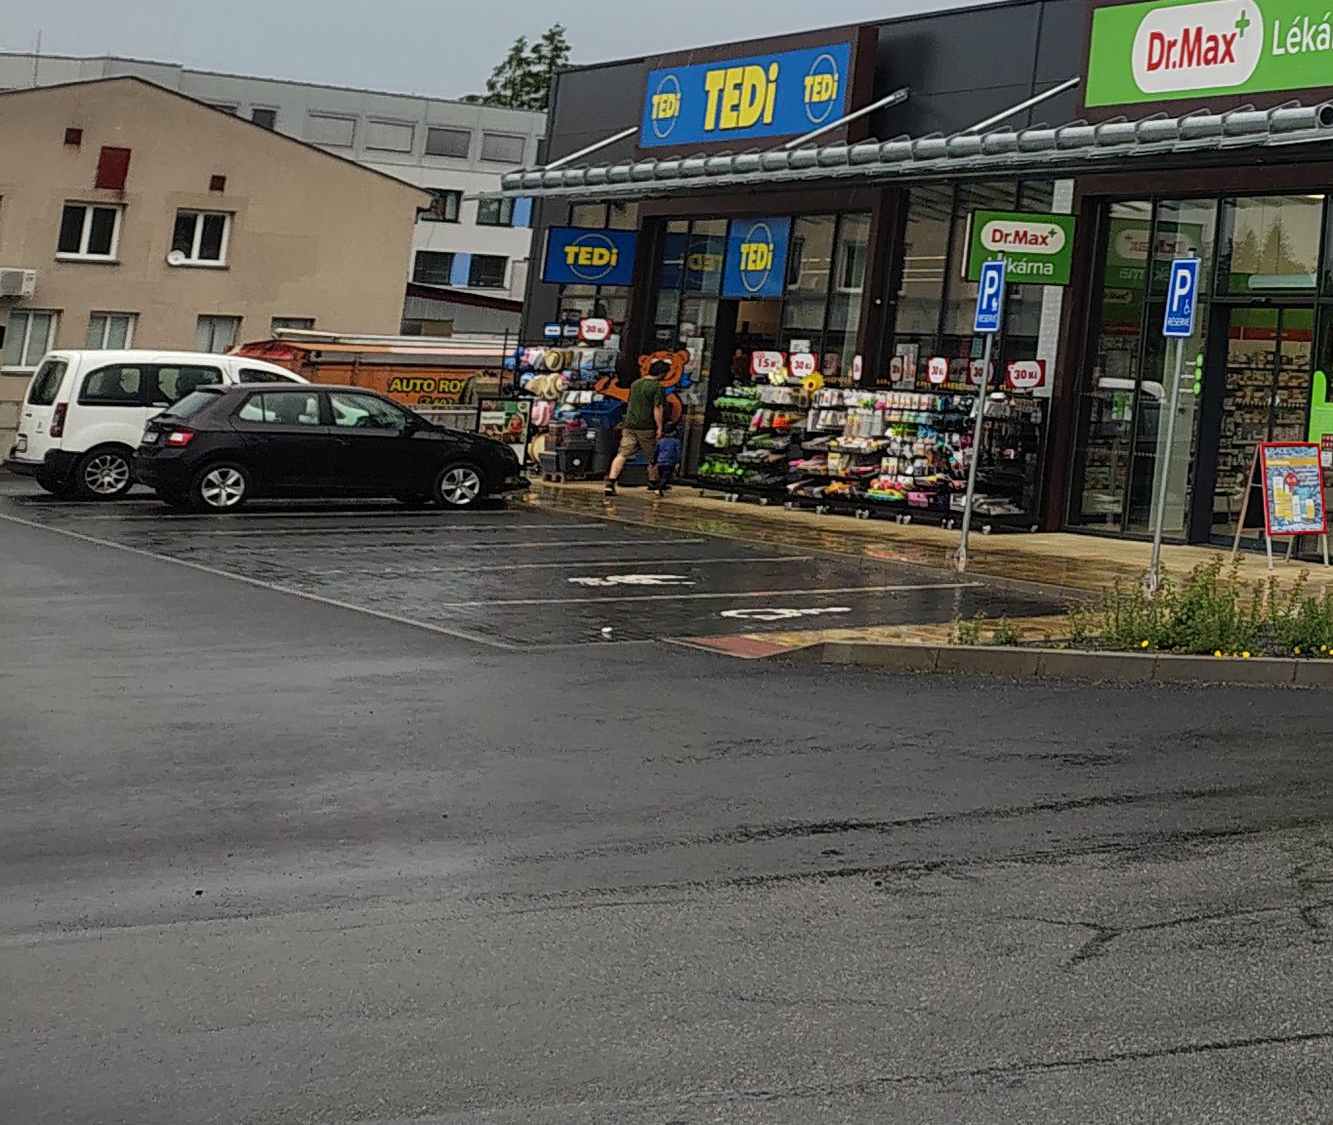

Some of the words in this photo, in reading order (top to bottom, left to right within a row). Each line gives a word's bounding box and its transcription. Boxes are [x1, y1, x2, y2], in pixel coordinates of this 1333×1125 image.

[704, 62, 779, 131] TEDi
[804, 73, 839, 104] TEDi
[652, 92, 681, 120] TEDi
[564, 245, 618, 267] TEDi
[740, 242, 774, 271] TEDi
[987, 257, 1054, 275] kárna
[982, 270, 999, 310] P
[1172, 269, 1191, 312] P
[388, 377, 436, 393] AUTO
